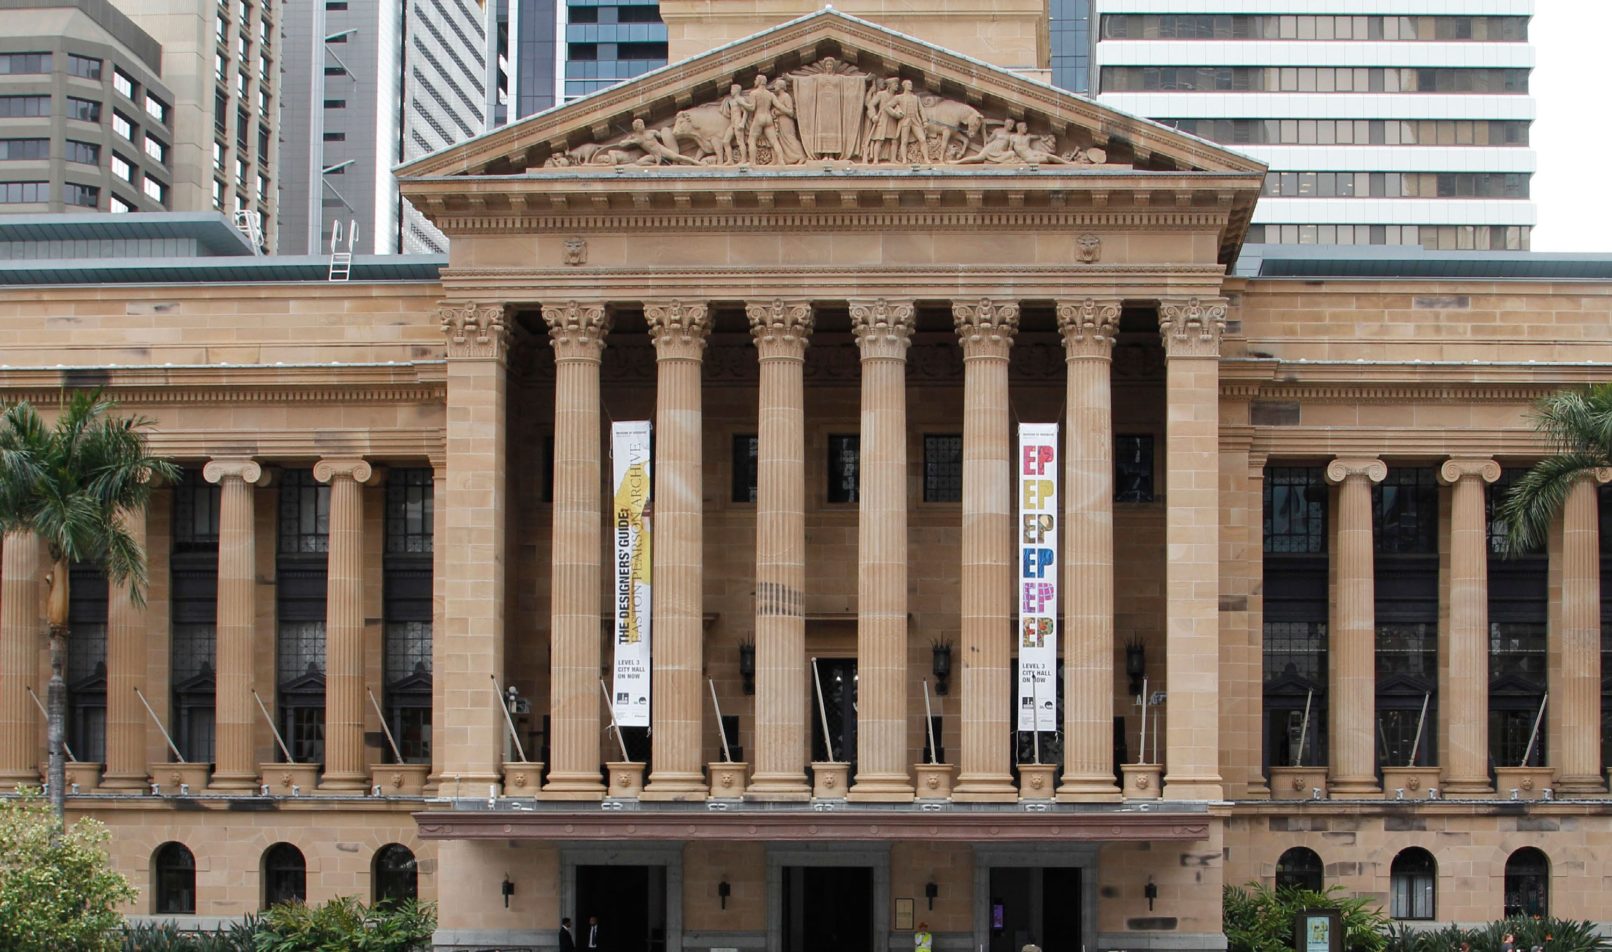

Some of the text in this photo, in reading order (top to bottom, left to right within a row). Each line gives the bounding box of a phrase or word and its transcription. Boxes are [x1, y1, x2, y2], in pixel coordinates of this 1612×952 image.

[1023, 445, 1054, 475] EP
[1023, 480, 1054, 509] EP
[630, 442, 642, 643] EASTON PEARSON ARCHIVE
[1023, 514, 1054, 544] EP
[1023, 548, 1054, 578] EP
[618, 550, 630, 619] DESIGNERS'
[1023, 583, 1054, 613] EP
[618, 622, 630, 645] THE
[1023, 617, 1054, 648] EP
